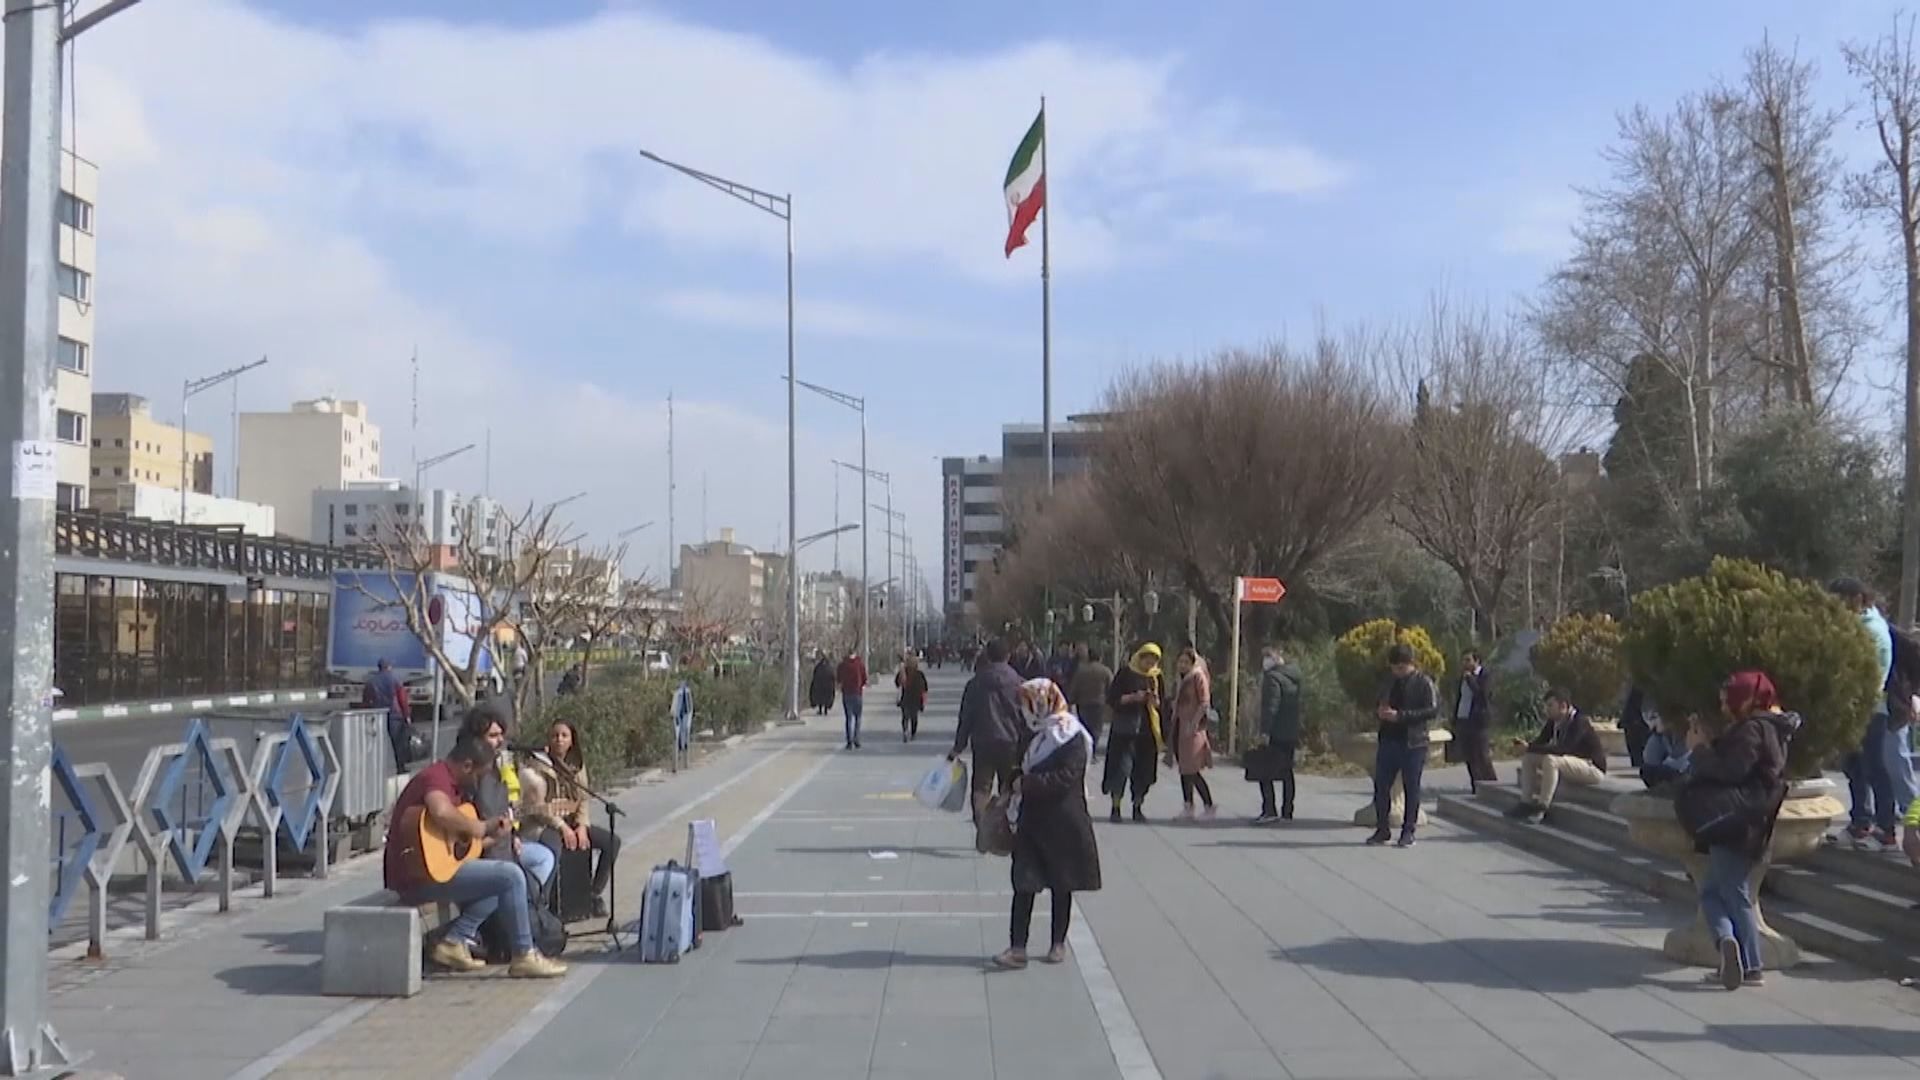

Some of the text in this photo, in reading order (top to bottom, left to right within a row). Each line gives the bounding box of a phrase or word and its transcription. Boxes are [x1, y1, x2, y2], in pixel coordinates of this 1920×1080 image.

[950, 479, 958, 598] RAZI HOTEL APT
